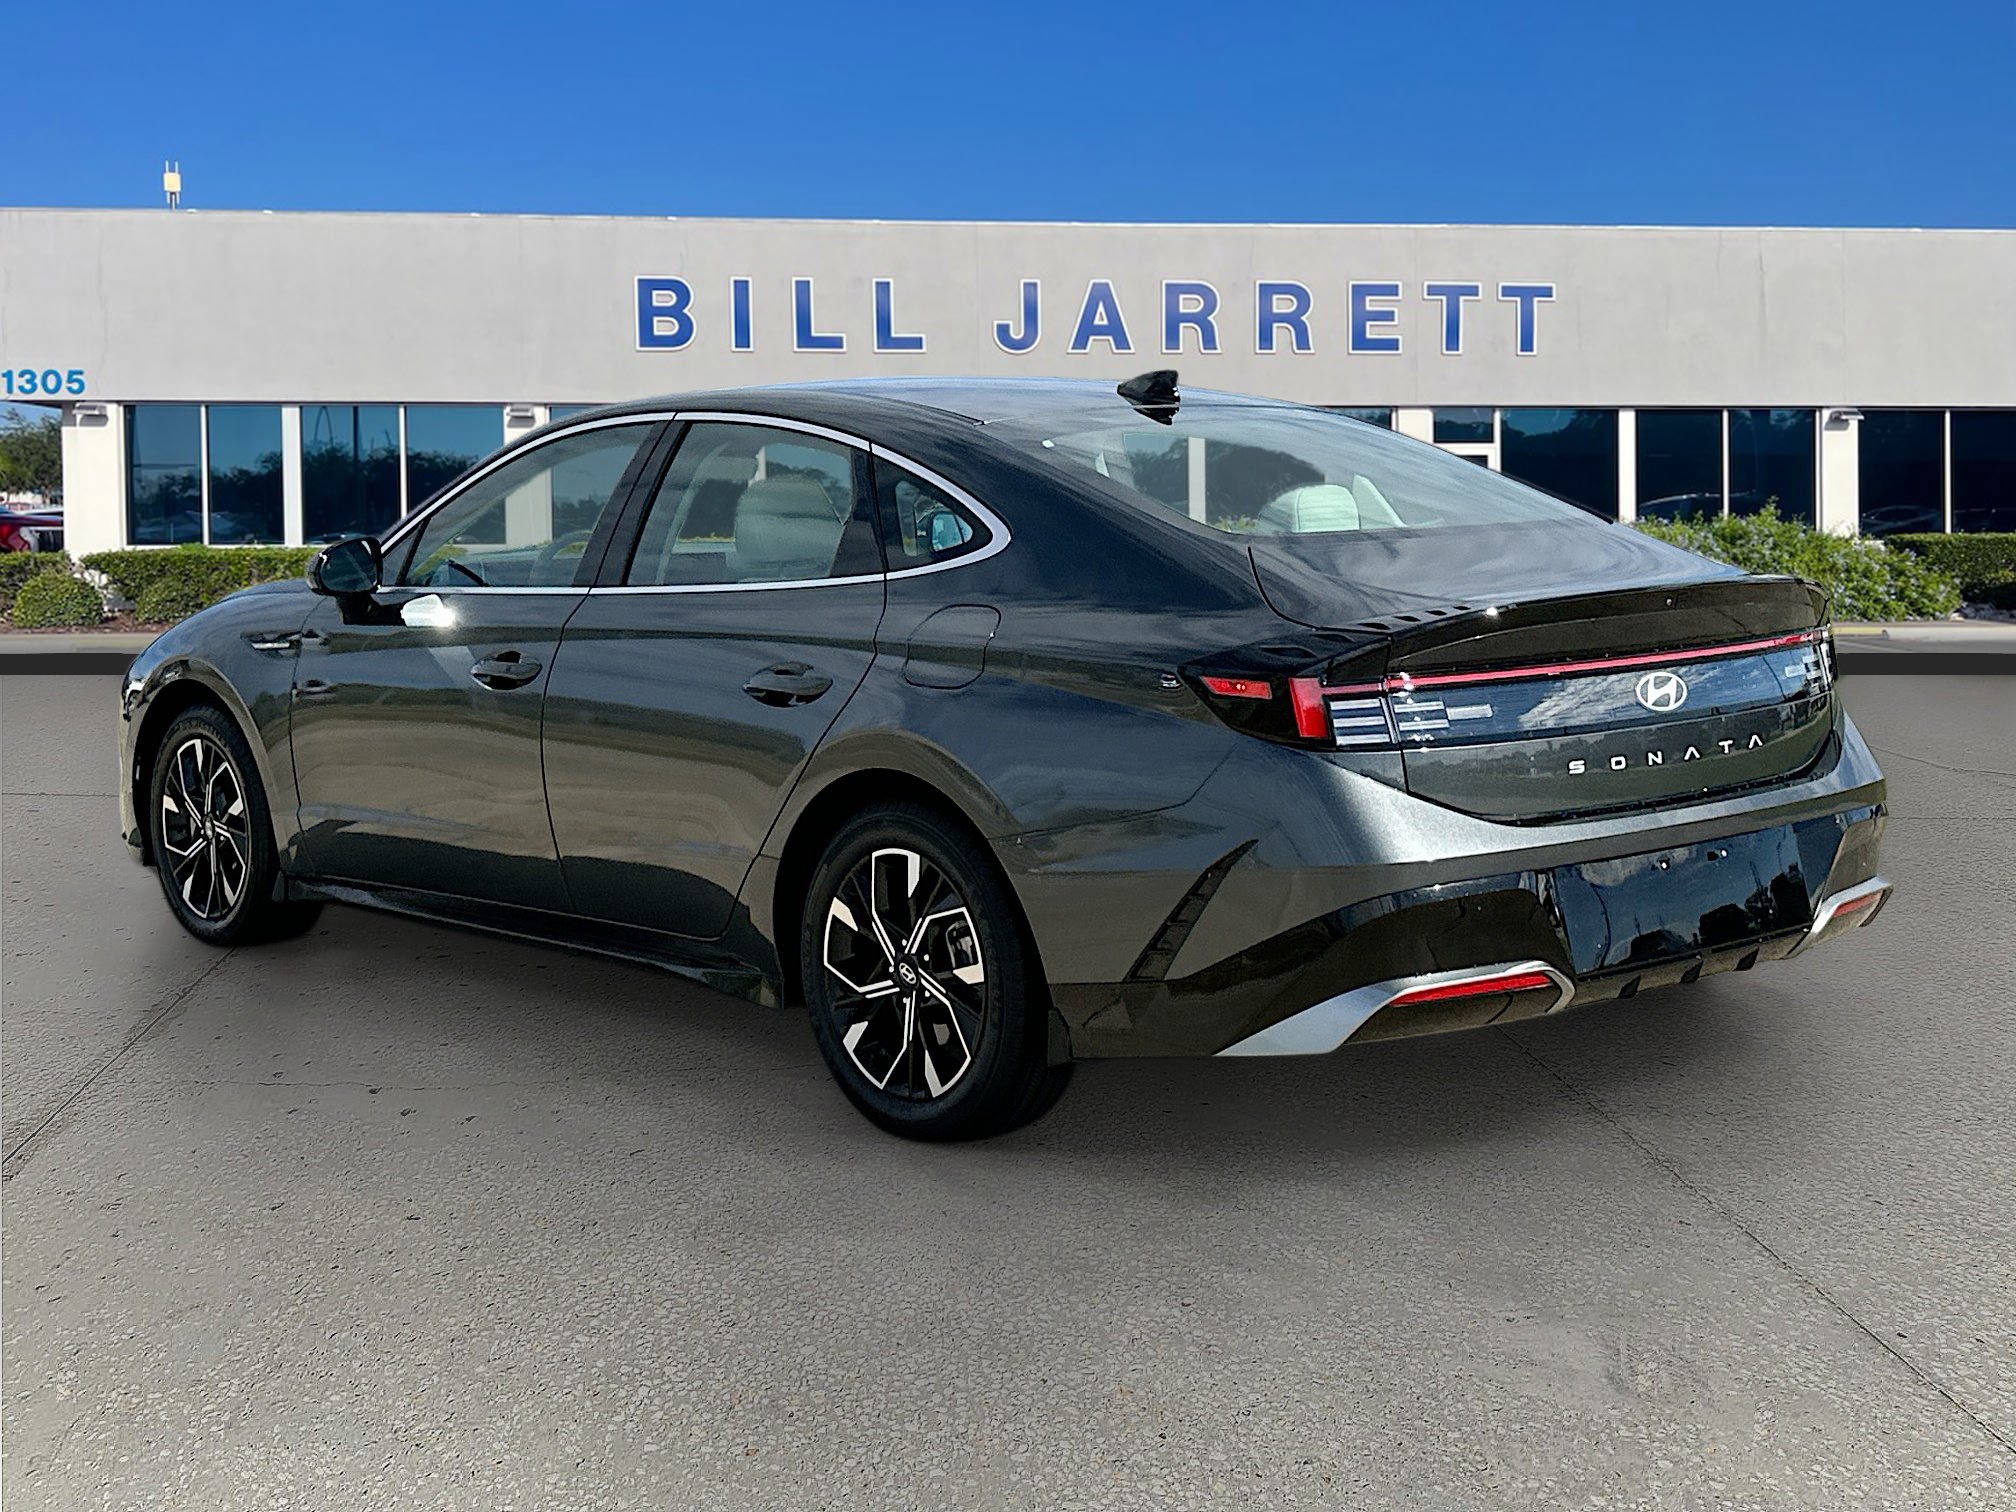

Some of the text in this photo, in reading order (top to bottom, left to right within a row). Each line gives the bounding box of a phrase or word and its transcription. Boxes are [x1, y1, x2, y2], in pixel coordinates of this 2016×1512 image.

[634, 275, 1556, 356] BILL JARRETT
[1, 368, 86, 395] 1305
[1568, 734, 1764, 775] SONATA
